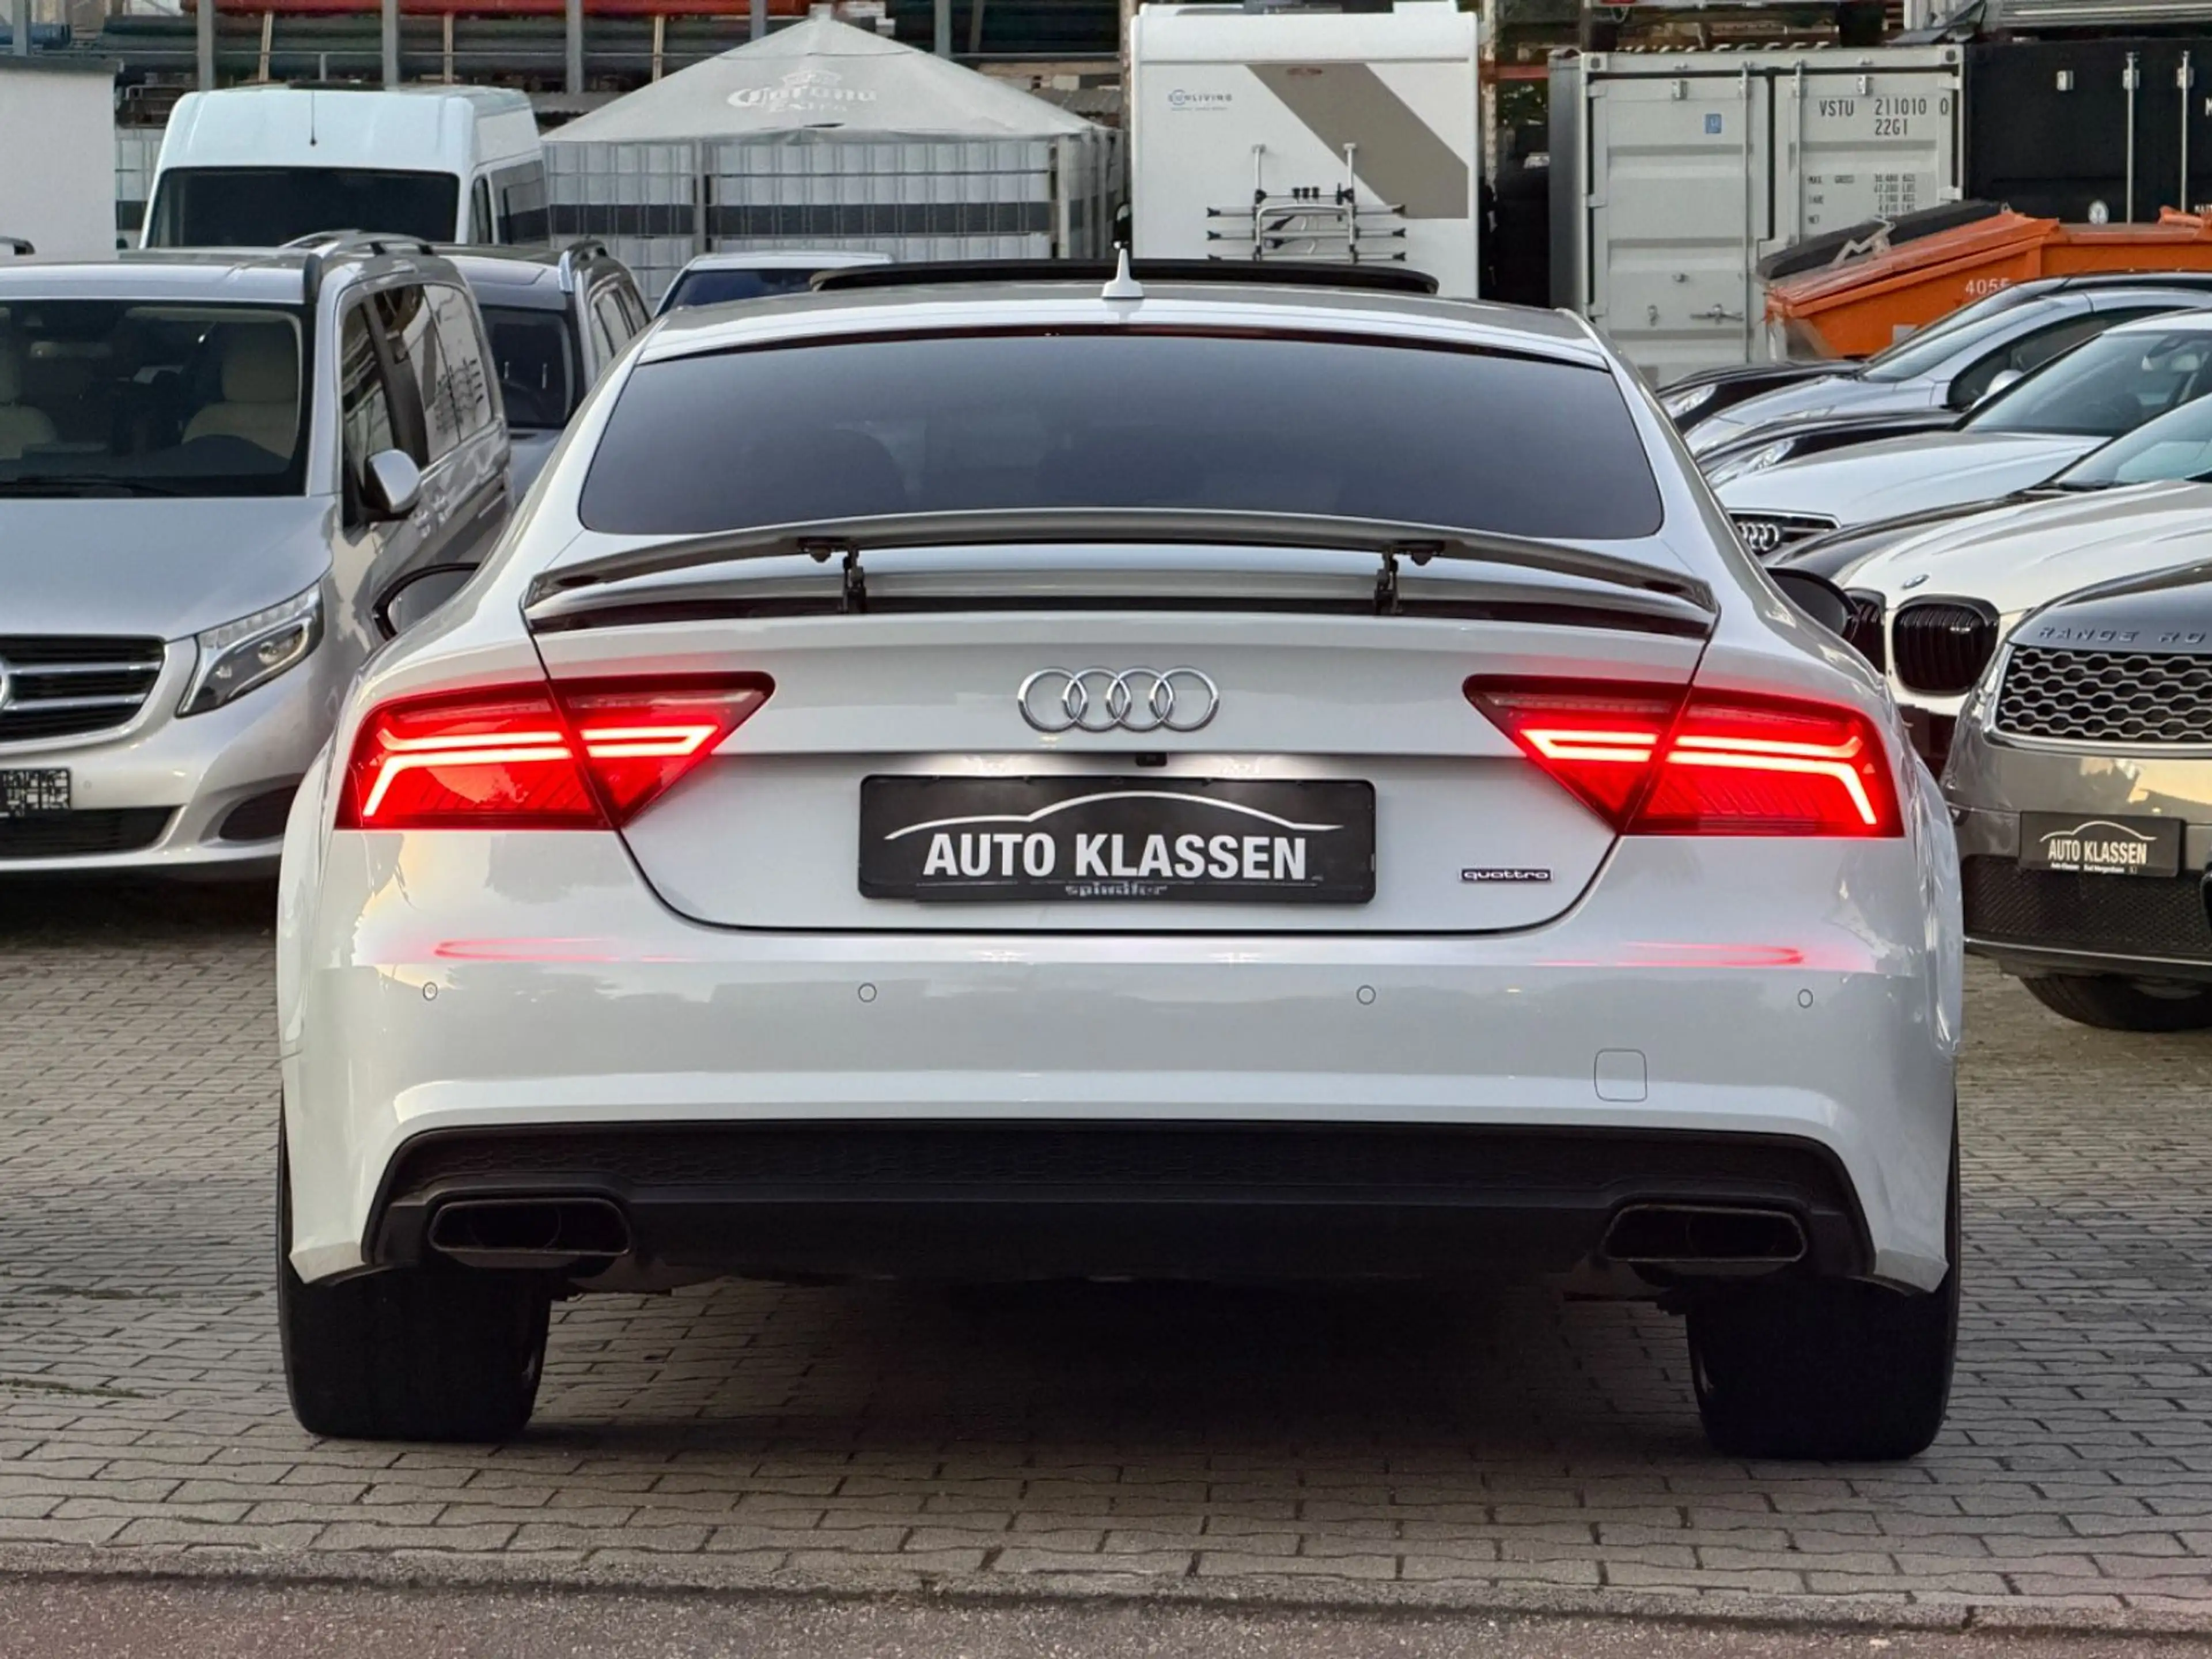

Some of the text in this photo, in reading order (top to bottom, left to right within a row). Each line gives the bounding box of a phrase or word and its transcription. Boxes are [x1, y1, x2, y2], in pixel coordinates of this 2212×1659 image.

[1819, 100, 1854, 116] VSTU
[1876, 98, 1927, 115] 211010
[2039, 627, 2139, 642] RANGE
[923, 832, 1306, 880] AUTO KLASSEN
[2048, 839, 2147, 864] AUTO KLASSEN
[1464, 870, 1548, 880] quattro
